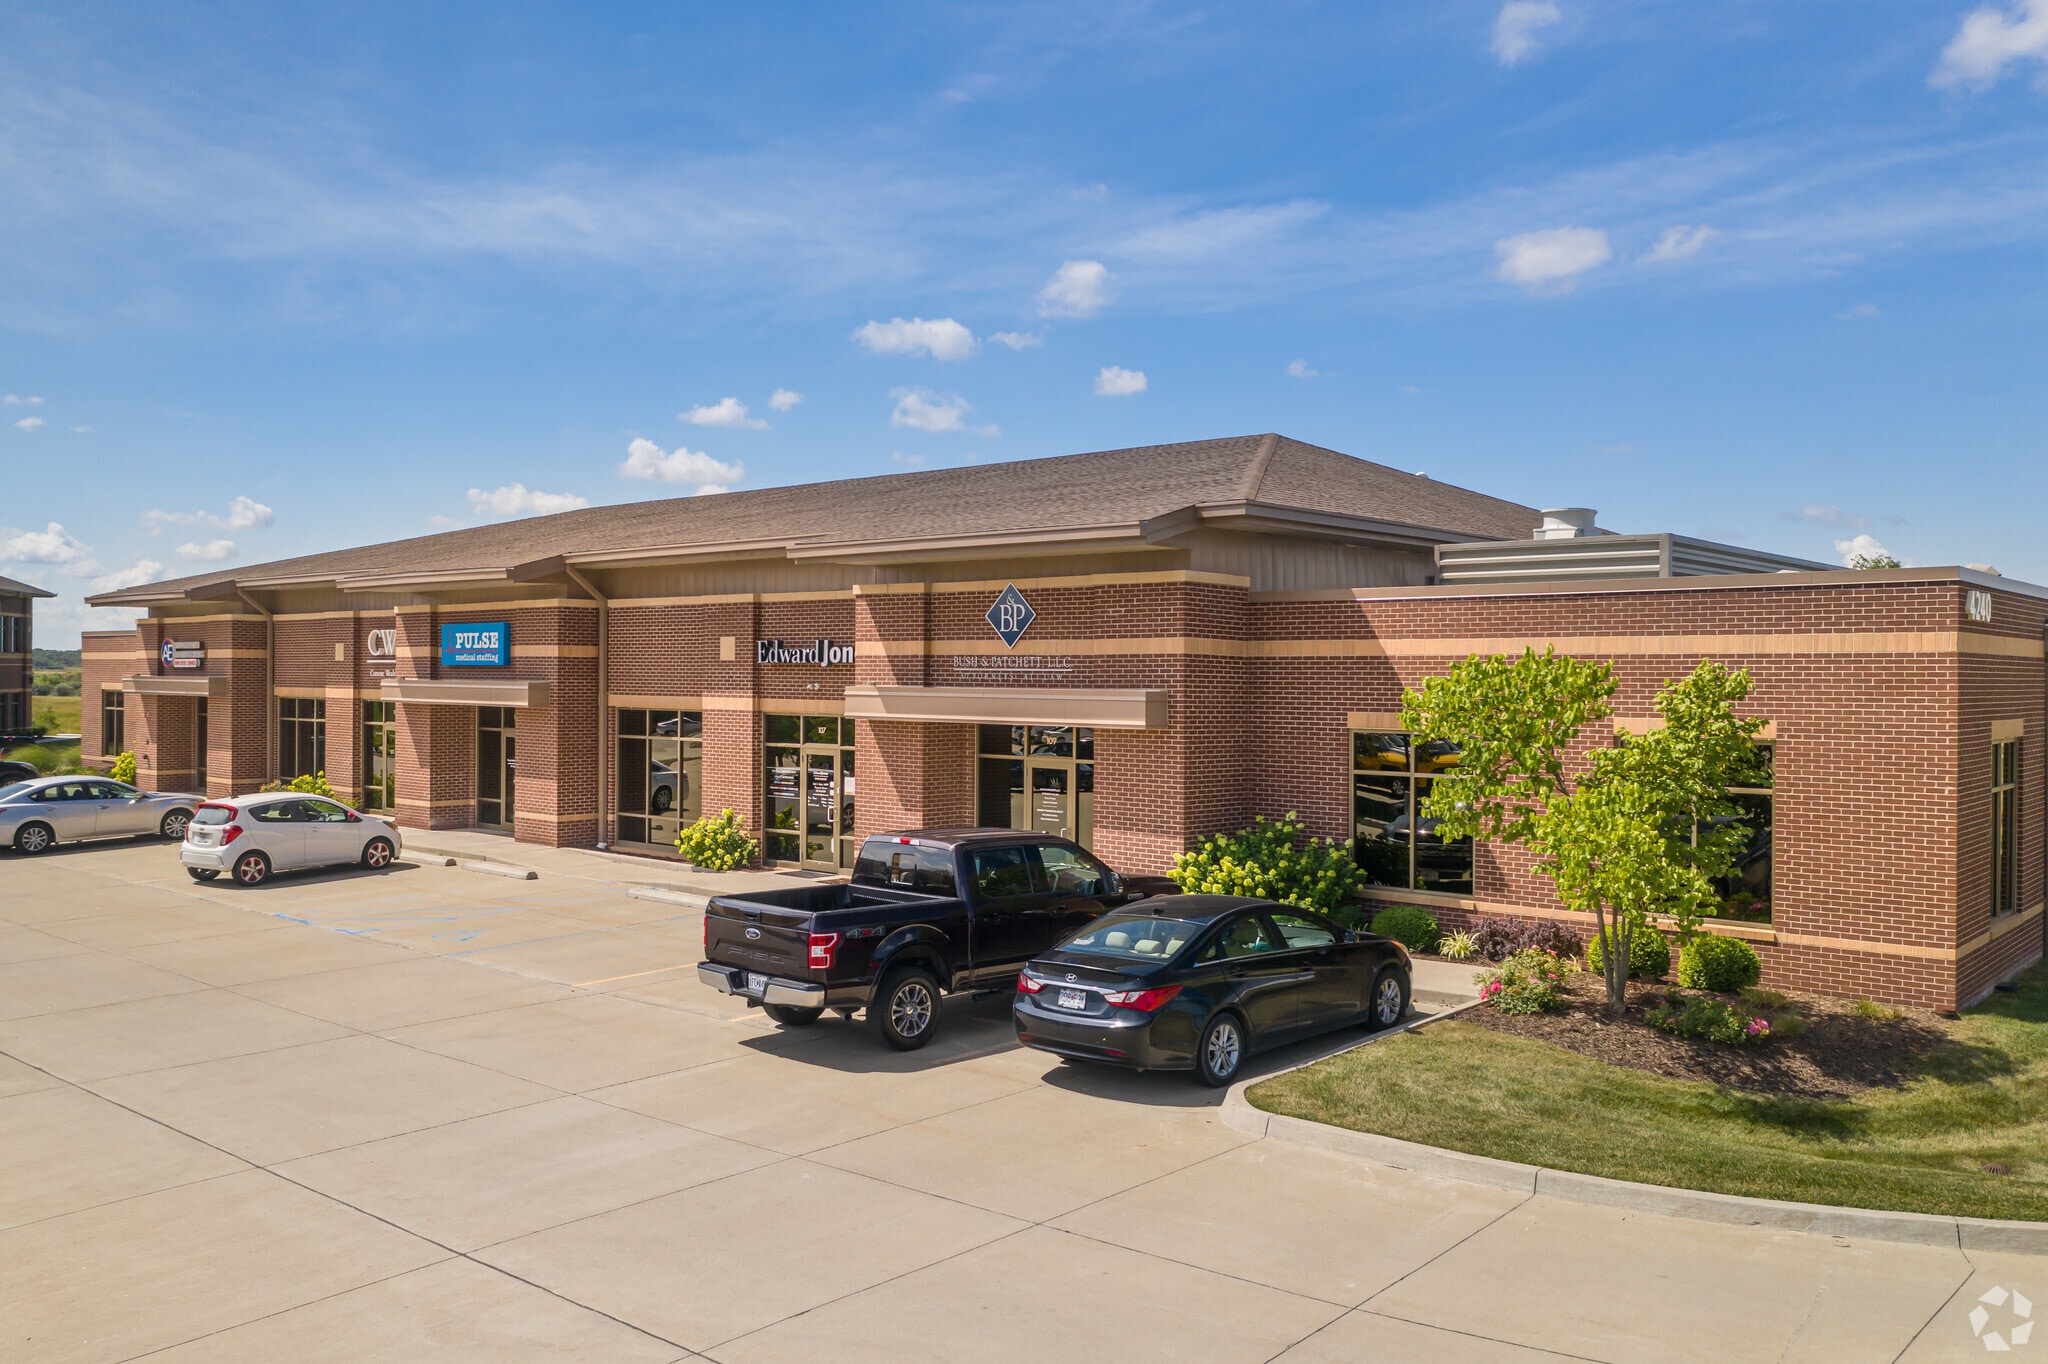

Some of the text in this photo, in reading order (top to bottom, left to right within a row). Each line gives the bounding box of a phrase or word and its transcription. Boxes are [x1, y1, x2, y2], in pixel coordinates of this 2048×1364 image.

[1968, 591, 1992, 623] 4240
[1000, 604, 1025, 632] BP
[455, 632, 499, 649] PULSE
[455, 653, 499, 664] medical staffing
[757, 640, 856, 667] Edward Jon
[953, 656, 978, 667] BUSH
[982, 656, 989, 667] &
[1046, 737, 1057, 745] 109
